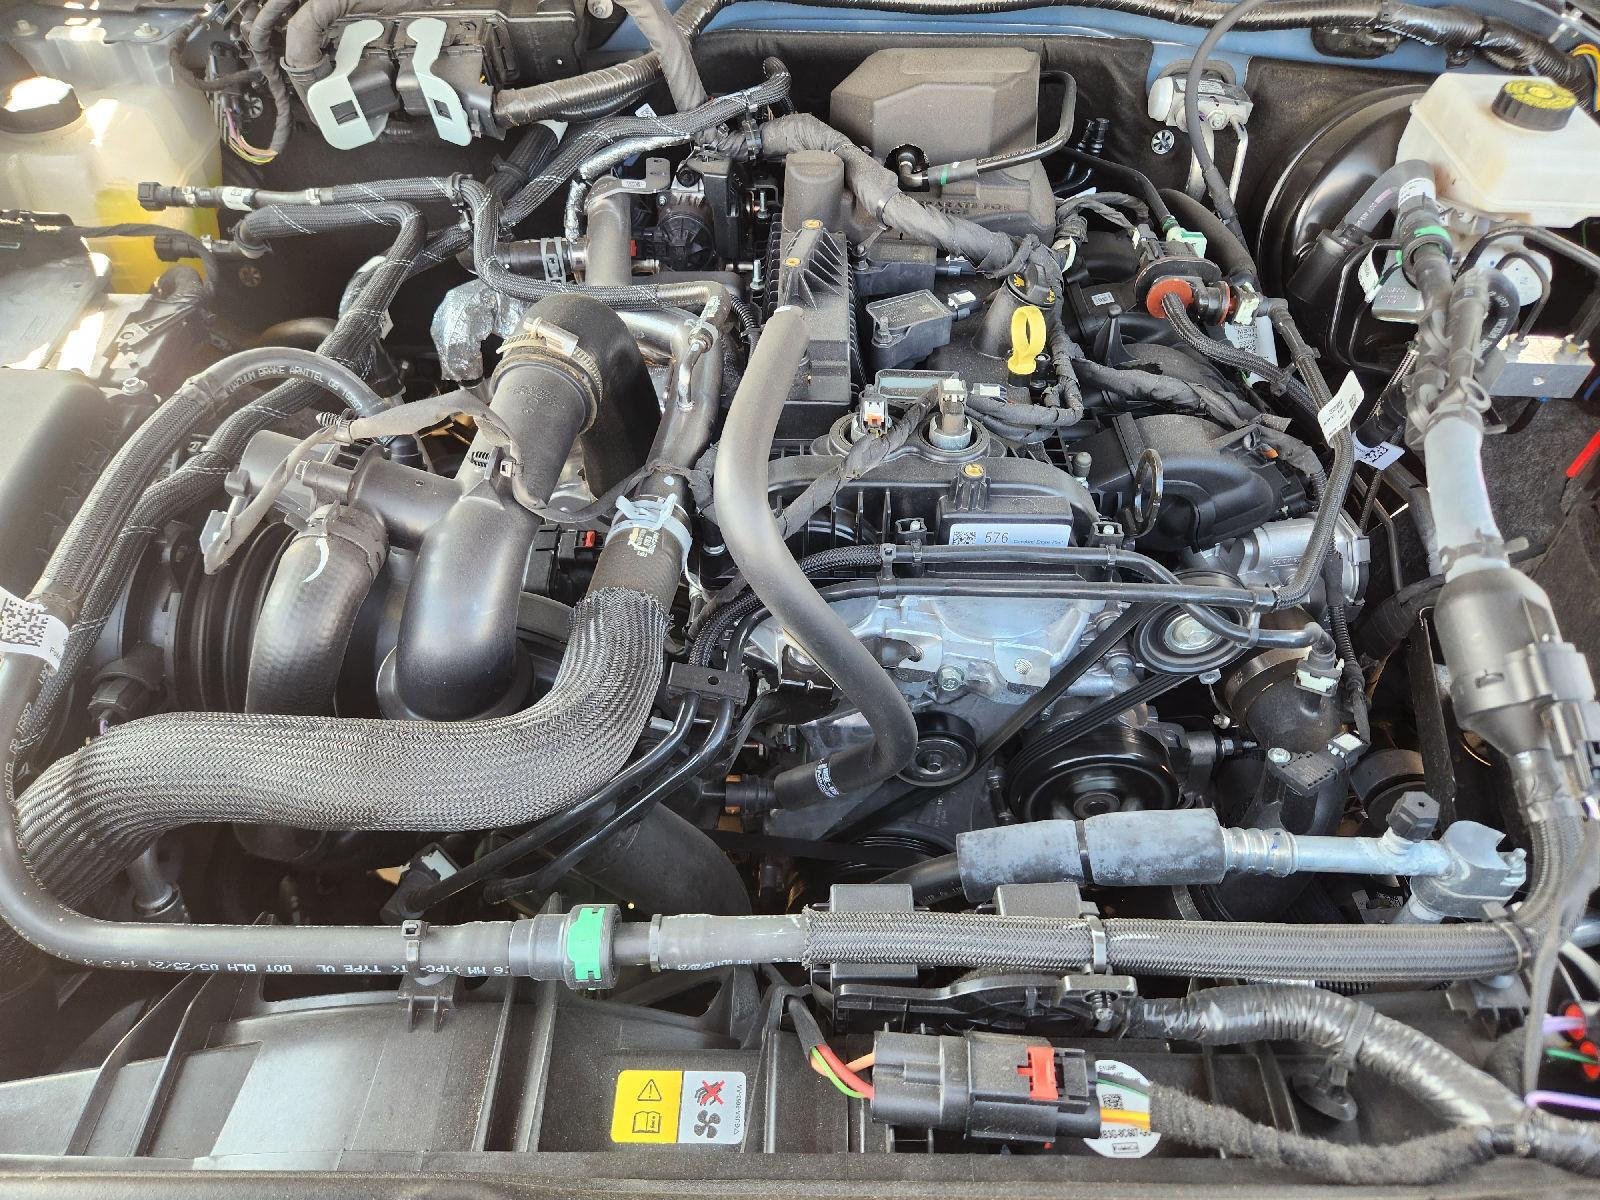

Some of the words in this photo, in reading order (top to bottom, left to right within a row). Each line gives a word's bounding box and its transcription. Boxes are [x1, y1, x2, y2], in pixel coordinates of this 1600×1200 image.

[258, 365, 285, 376] BRAKE
[985, 531, 1009, 544] 576
[228, 962, 257, 972] DLH
[265, 963, 293, 974] DOT
[344, 964, 382, 973] TYPE
